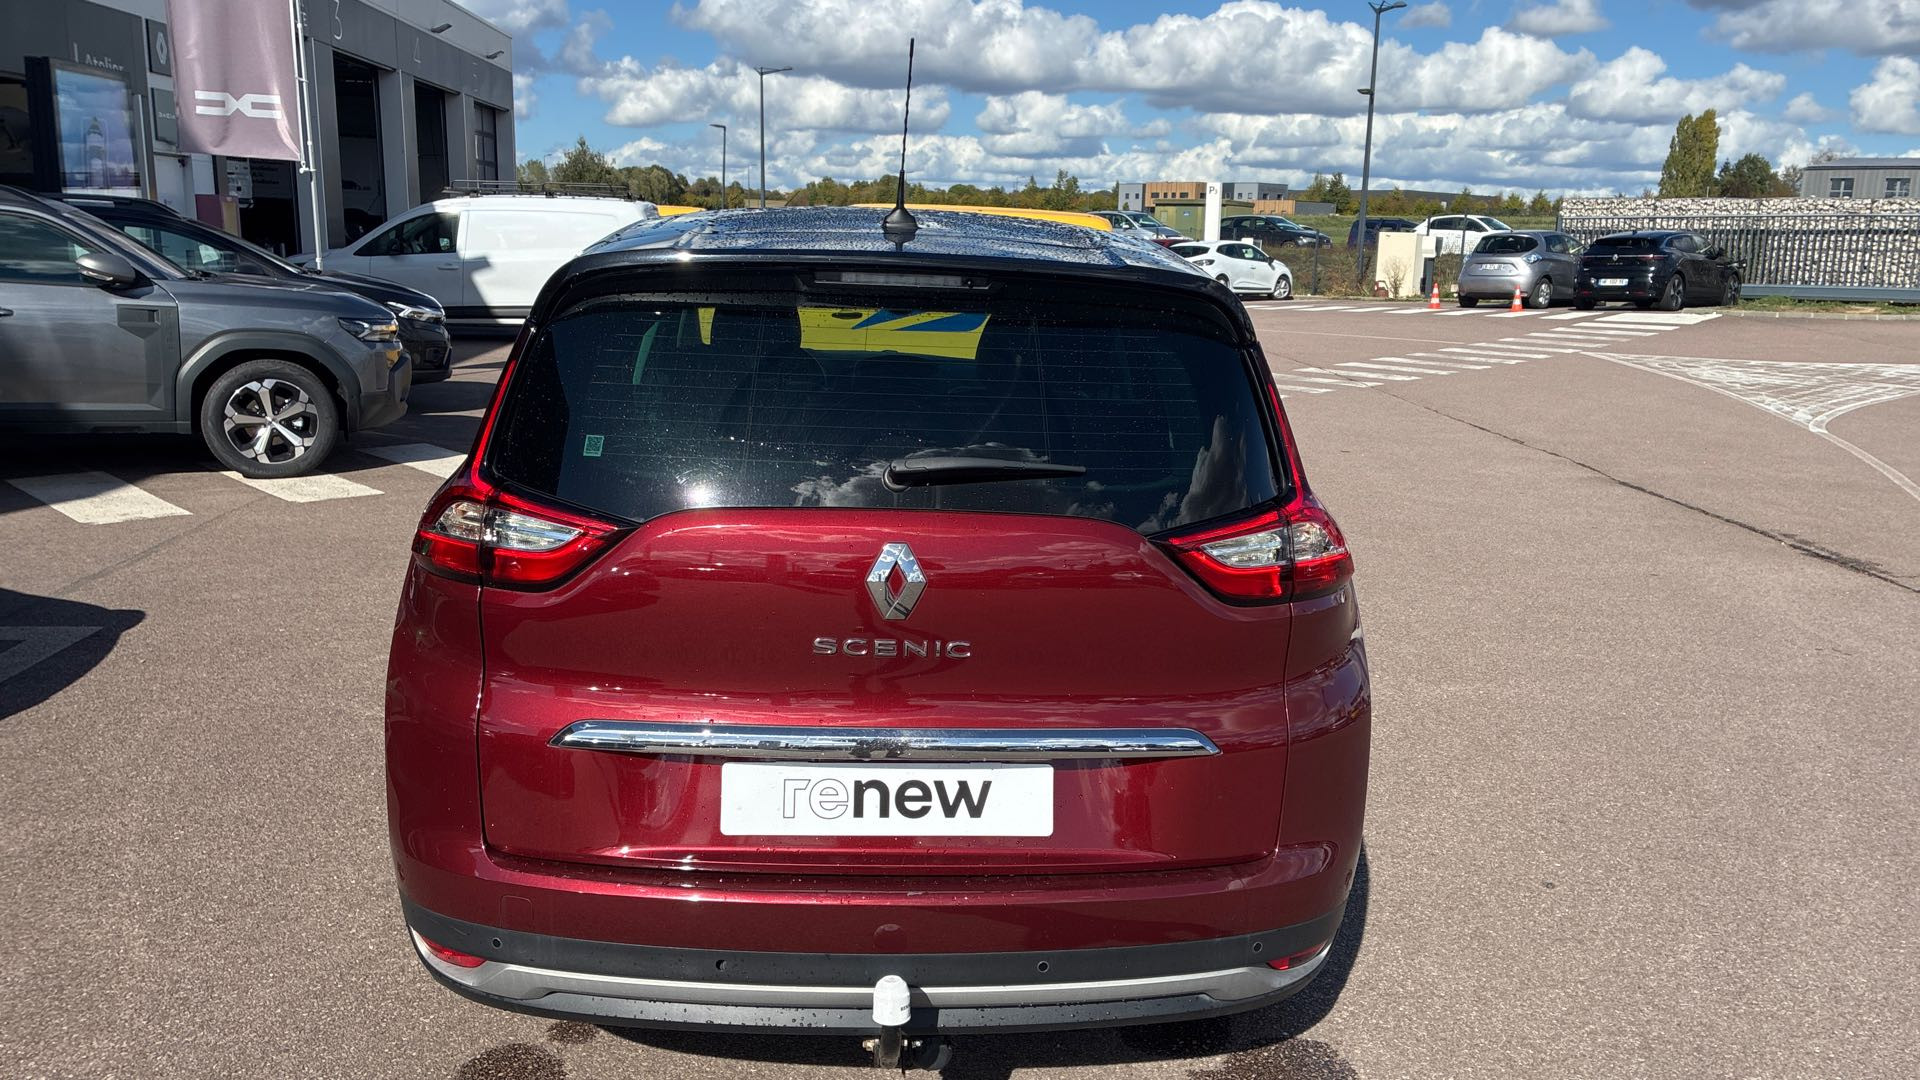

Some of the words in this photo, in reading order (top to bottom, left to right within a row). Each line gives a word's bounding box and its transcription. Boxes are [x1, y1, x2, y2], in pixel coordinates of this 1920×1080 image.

[334, 0, 343, 40] 3
[812, 636, 972, 659] SCENIC
[782, 777, 992, 819] renew
